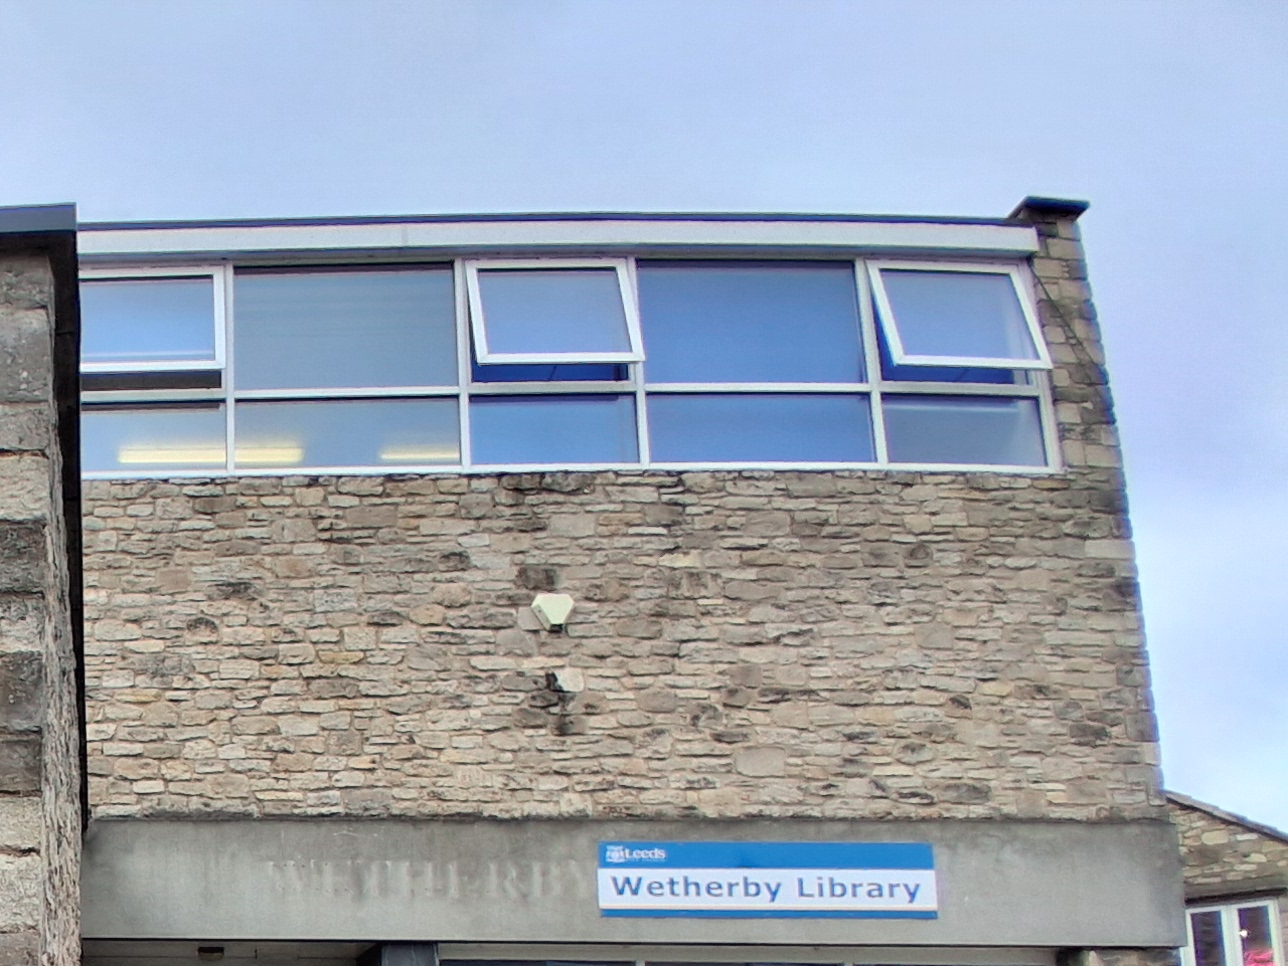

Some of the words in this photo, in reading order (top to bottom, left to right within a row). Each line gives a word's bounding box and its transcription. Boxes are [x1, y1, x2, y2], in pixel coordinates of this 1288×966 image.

[624, 846, 667, 859] Leeds
[610, 875, 782, 903] Wetherby
[796, 876, 921, 904] Library
